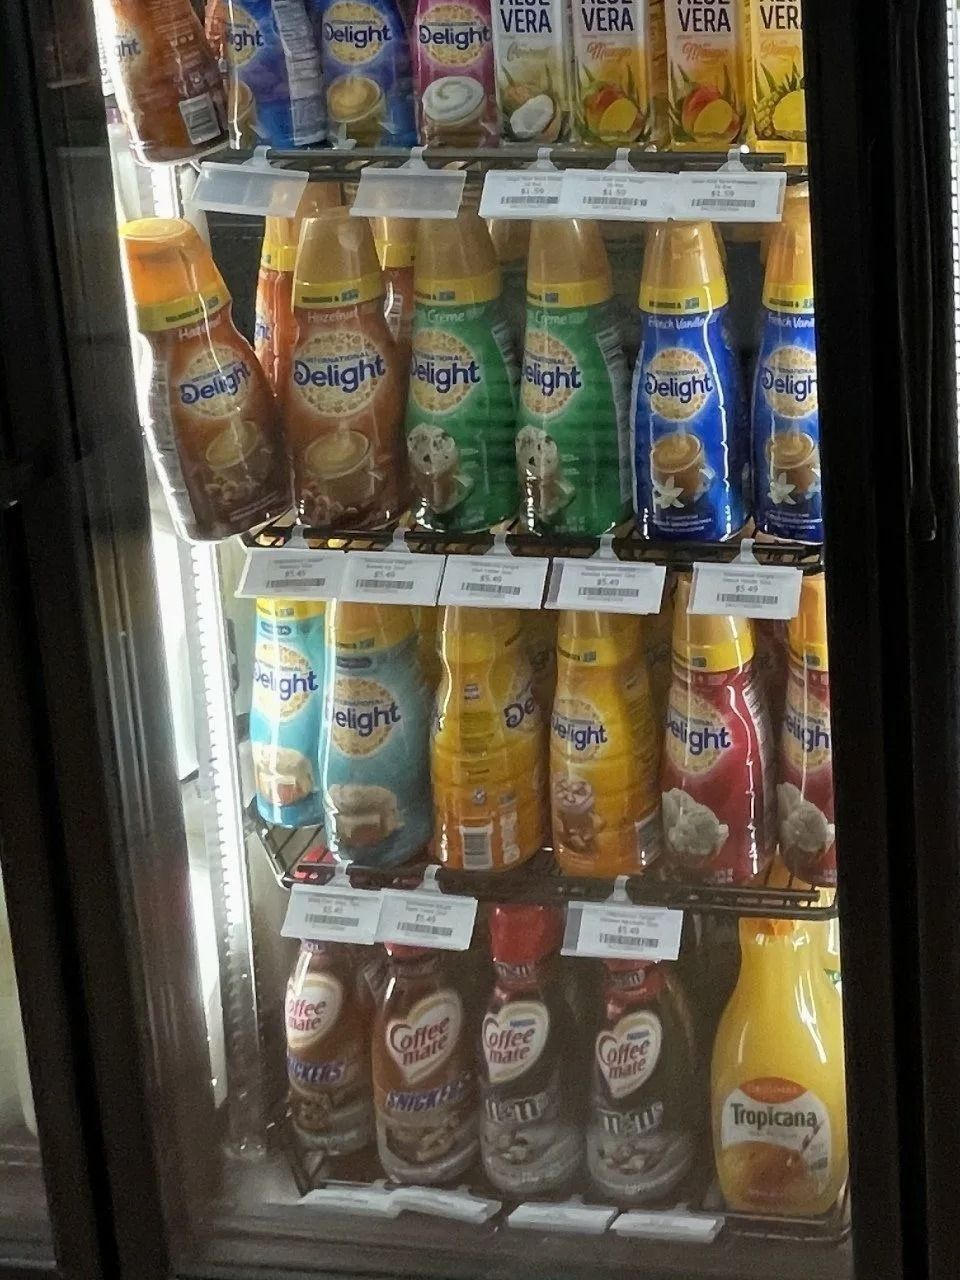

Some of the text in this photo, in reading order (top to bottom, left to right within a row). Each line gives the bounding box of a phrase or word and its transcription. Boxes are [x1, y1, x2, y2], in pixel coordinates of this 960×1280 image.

[500, 8, 552, 34] VERA
[582, 7, 634, 32] VERA
[677, 7, 732, 33] VERA
[759, 5, 802, 30] VER
[323, 22, 393, 50] Delight
[419, 24, 493, 51] Delight
[179, 360, 250, 405] Delight
[294, 355, 386, 393] Delight
[644, 372, 713, 404] Delight
[389, 1017, 450, 1053] Coffee
[486, 1018, 536, 1051] Coffee
[402, 1034, 449, 1066] mate
[489, 1046, 531, 1065] mate
[600, 1034, 650, 1067] Coffee
[608, 1058, 648, 1080] mate
[730, 1102, 818, 1131] Tropicana
